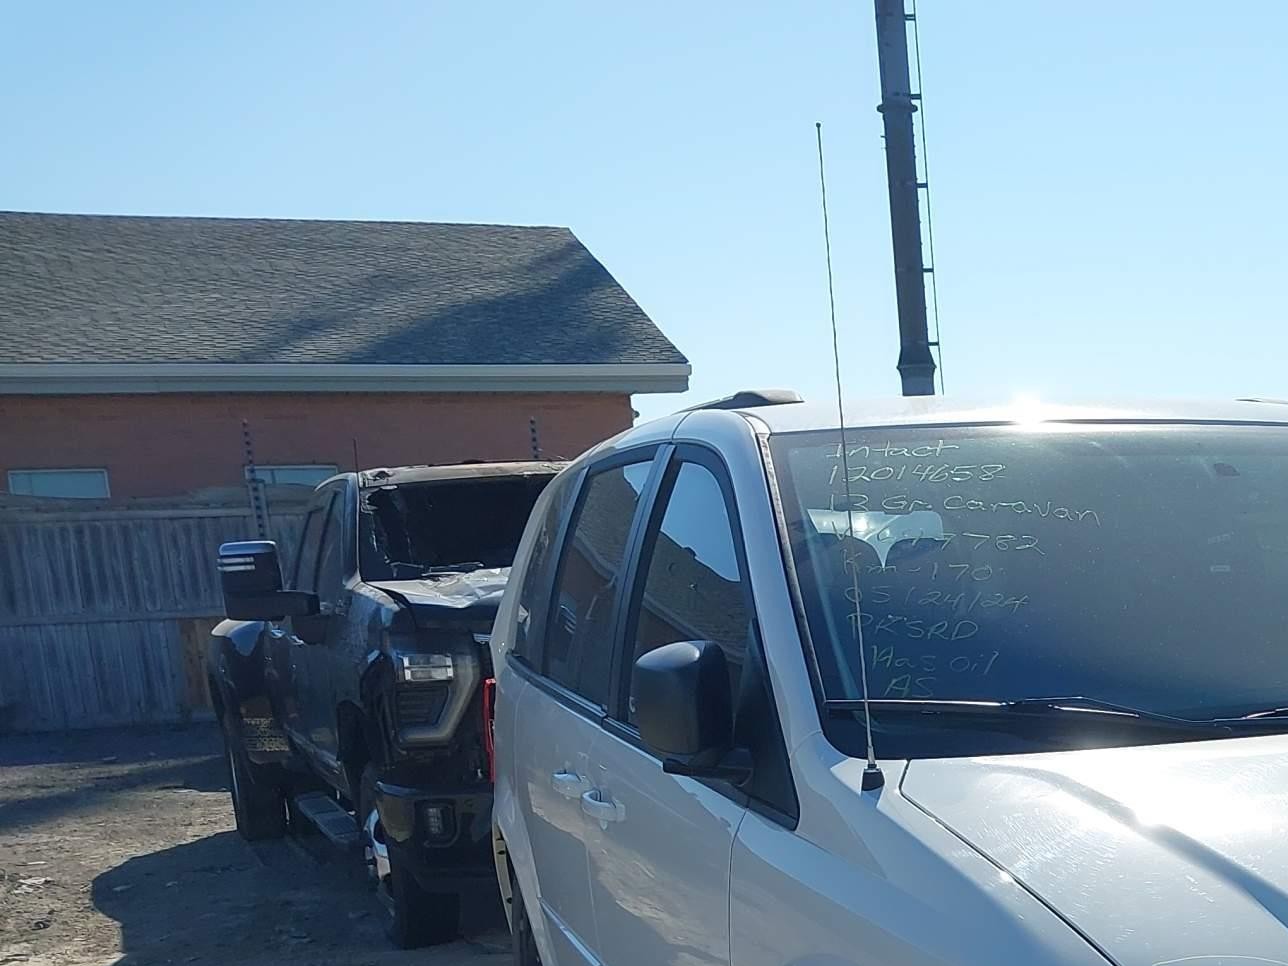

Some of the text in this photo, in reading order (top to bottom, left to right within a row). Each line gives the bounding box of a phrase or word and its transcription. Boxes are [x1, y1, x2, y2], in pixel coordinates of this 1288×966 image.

[826, 440, 959, 458] Intact
[829, 464, 1006, 484] 12014658
[943, 496, 1101, 527] Caravan
